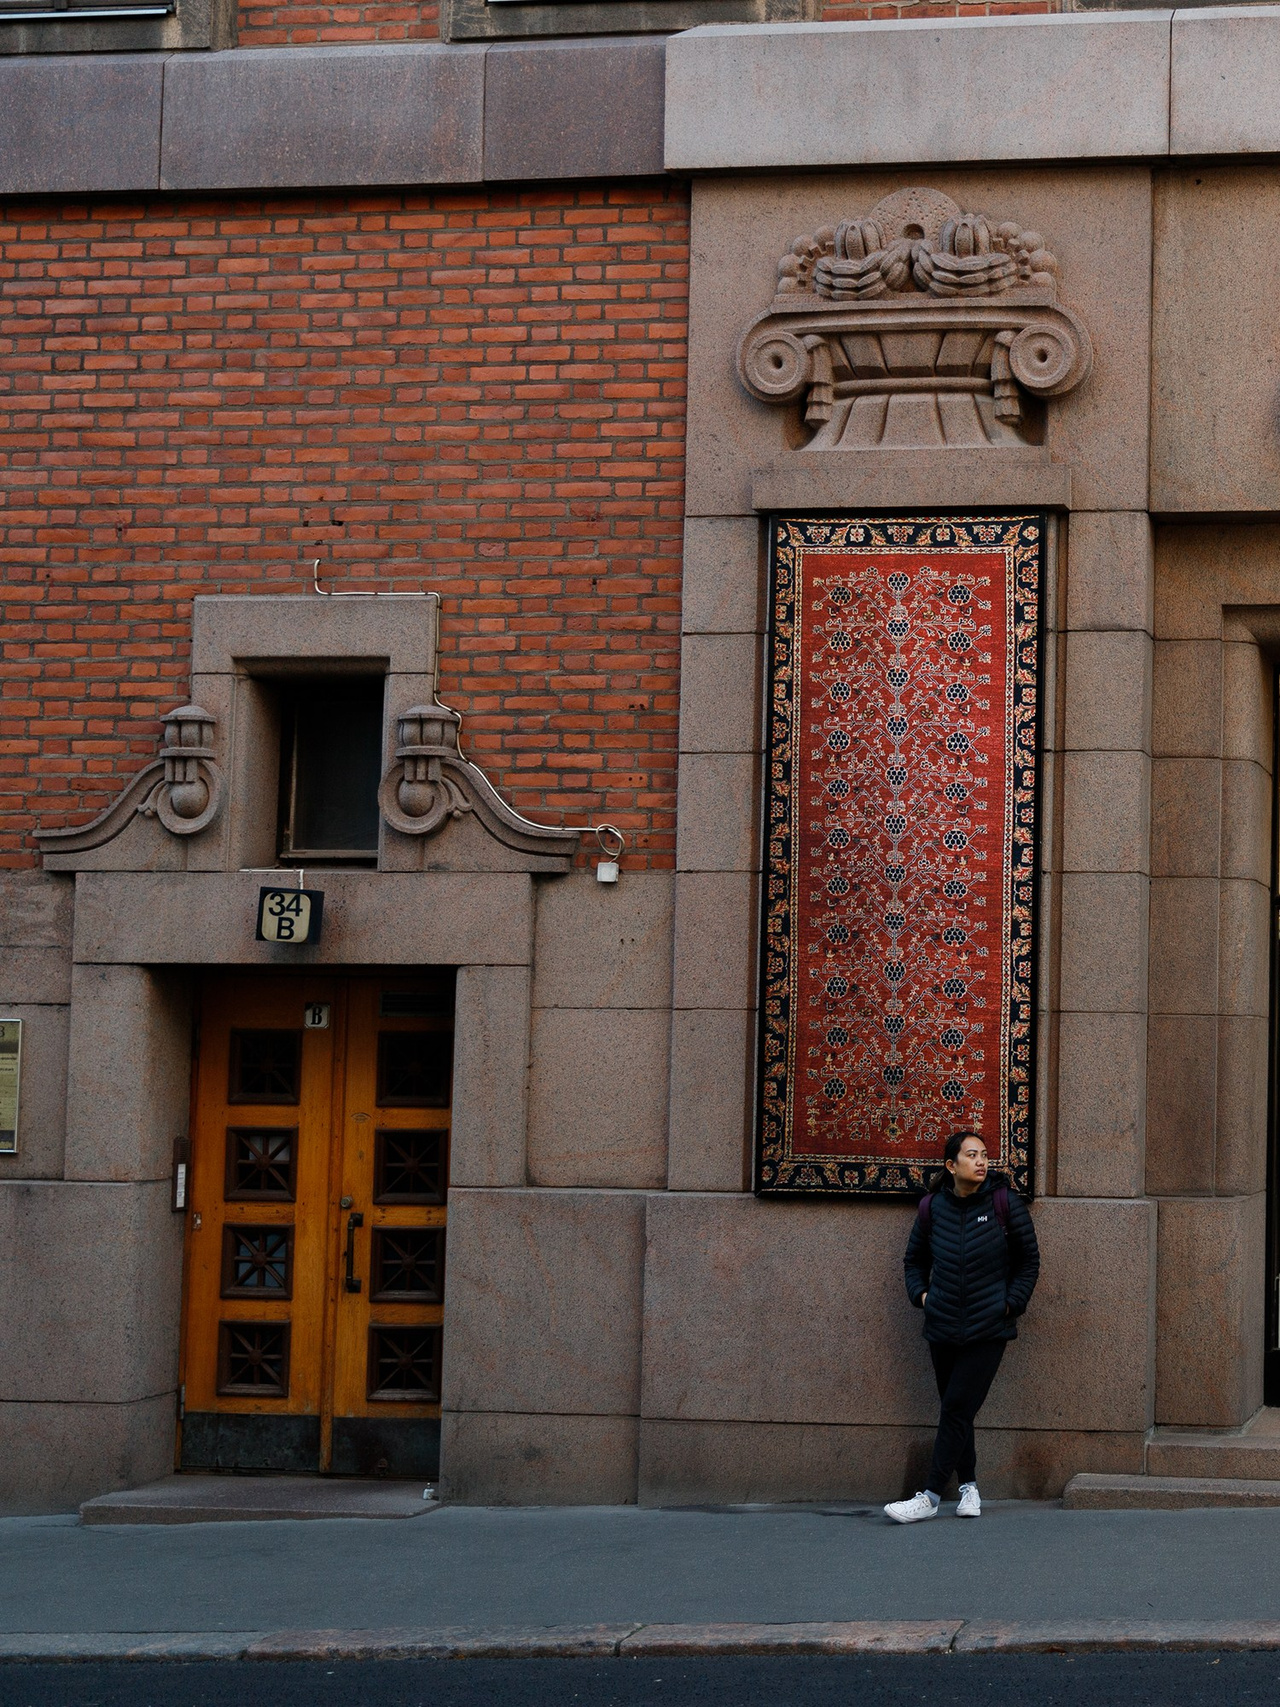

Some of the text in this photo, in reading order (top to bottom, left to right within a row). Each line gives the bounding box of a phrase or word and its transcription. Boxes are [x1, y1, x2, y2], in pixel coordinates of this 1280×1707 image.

[268, 891, 304, 917] 34
[276, 916, 295, 940] B
[310, 1006, 323, 1025] B
